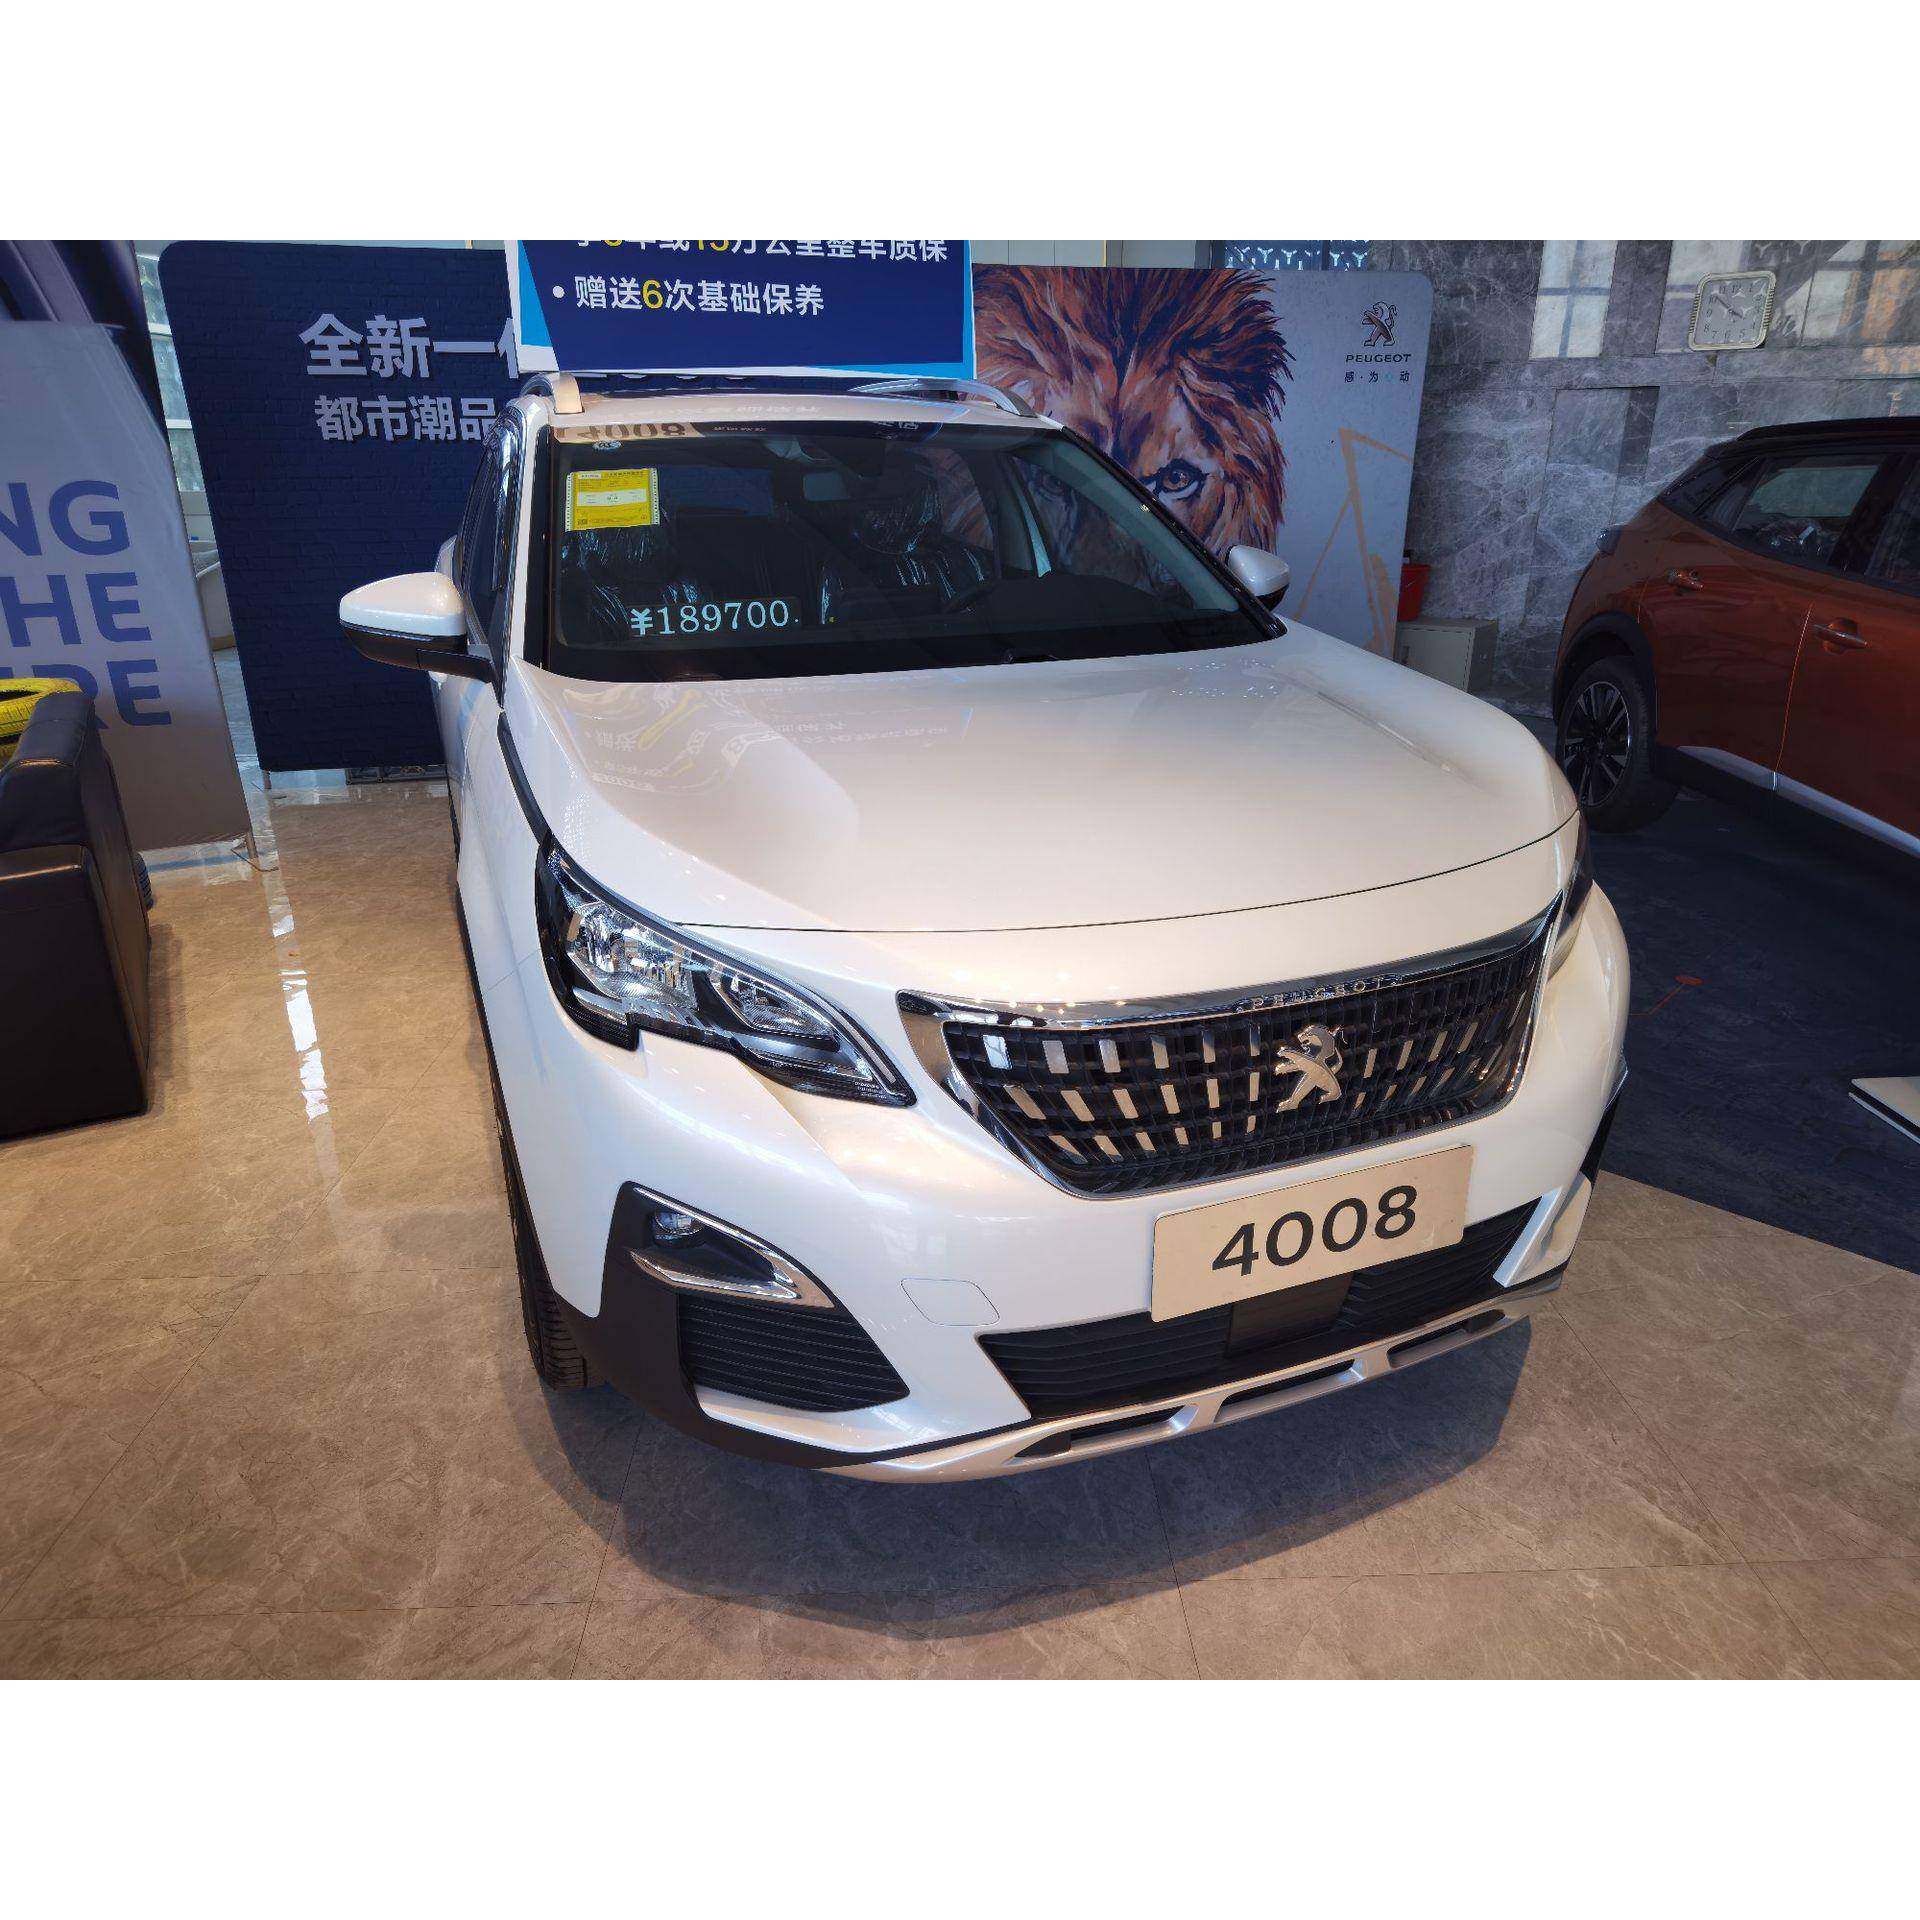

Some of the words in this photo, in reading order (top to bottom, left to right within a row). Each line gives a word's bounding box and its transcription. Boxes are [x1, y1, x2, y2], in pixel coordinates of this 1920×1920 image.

[574, 274, 825, 316] 赠送6次基础保养
[1345, 353, 1412, 363] PEUGEOT
[314, 394, 500, 442] 都市潮品
[1211, 1185, 1418, 1277] 4008
